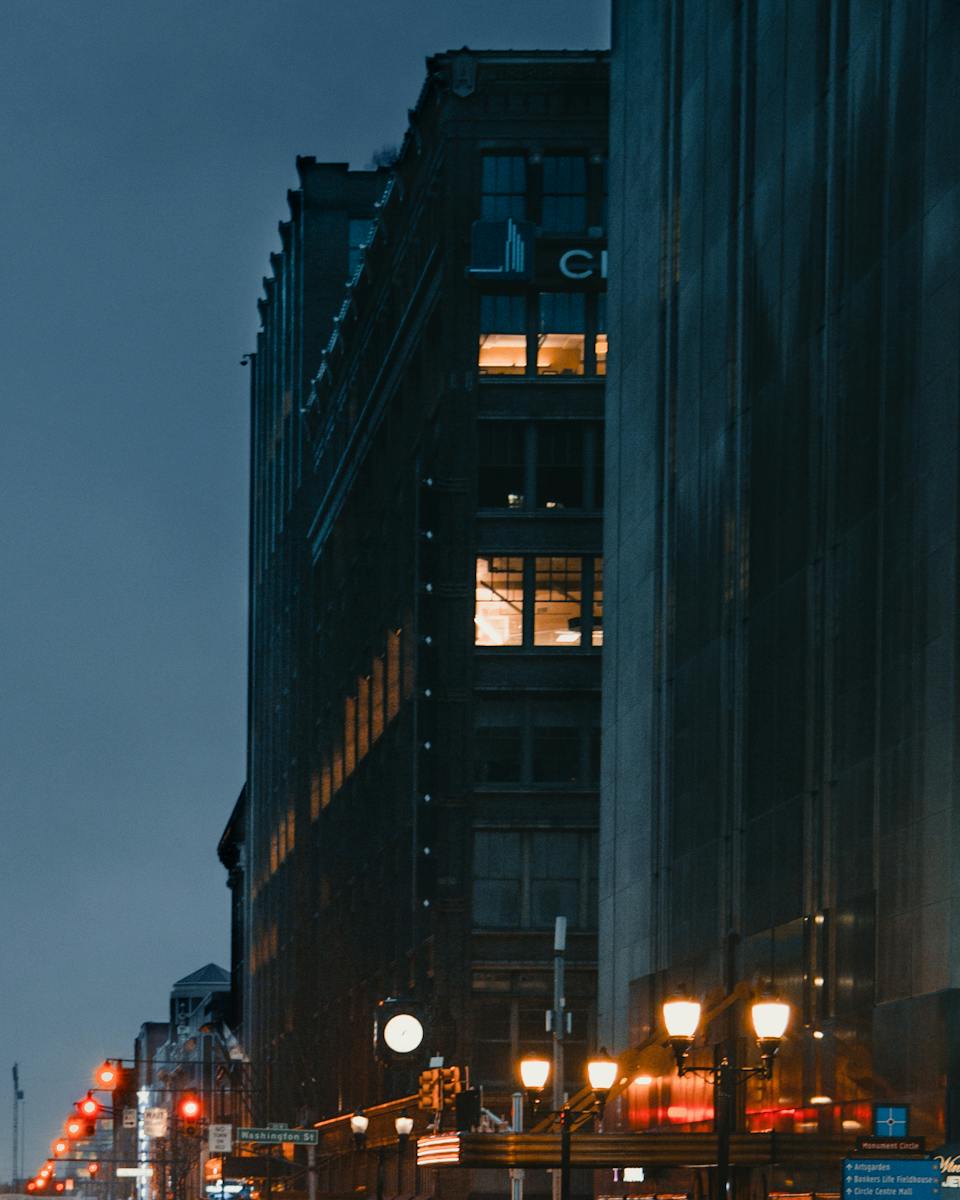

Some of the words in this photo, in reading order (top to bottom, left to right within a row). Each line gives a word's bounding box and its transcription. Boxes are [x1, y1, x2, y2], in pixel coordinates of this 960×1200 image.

[240, 1130, 300, 1142] Washington
[303, 1132, 315, 1141] St
[854, 1163, 890, 1172] Artsgarden
[853, 1175, 880, 1183] Bankers
[882, 1175, 895, 1183] Life
[896, 1175, 933, 1184] Fieldhouse
[854, 1187, 873, 1195] Circle
[875, 1187, 897, 1195] Centre
[898, 1187, 913, 1195] Mall
